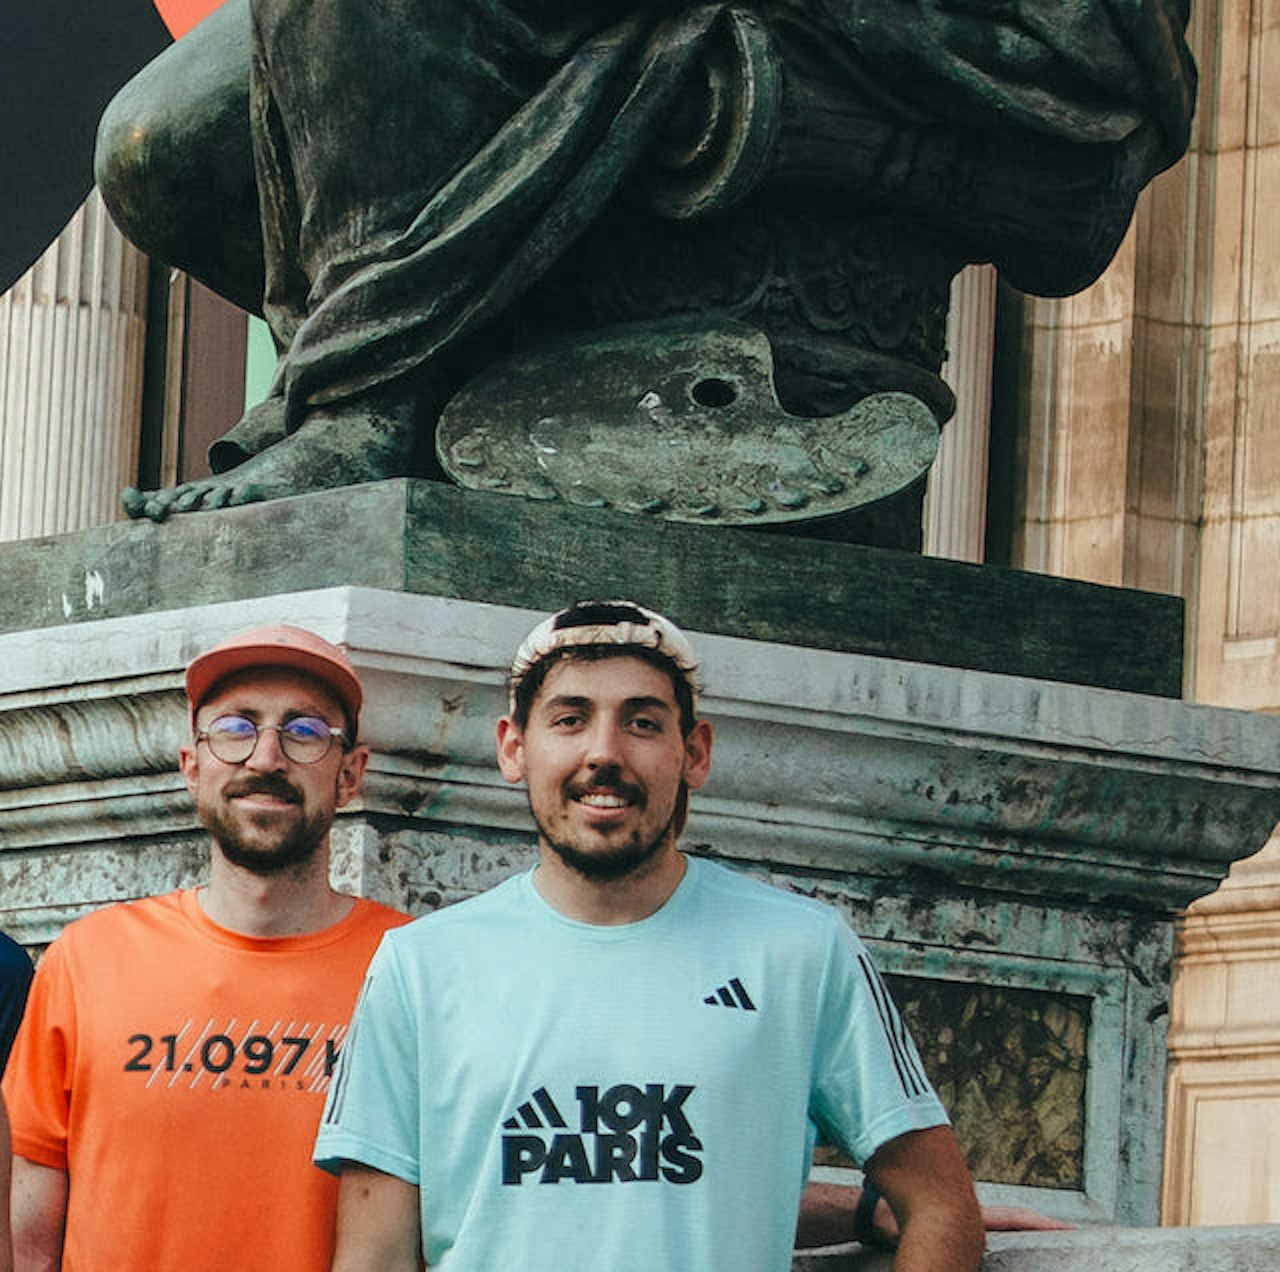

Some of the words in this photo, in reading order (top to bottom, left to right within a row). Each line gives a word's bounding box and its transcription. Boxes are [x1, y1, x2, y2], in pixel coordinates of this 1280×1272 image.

[124, 1033, 311, 1075] 21.097
[325, 1039, 342, 1078] K
[221, 1078, 305, 1090] PARIS
[576, 1084, 696, 1136] 10K
[502, 1134, 704, 1184] PARIS
